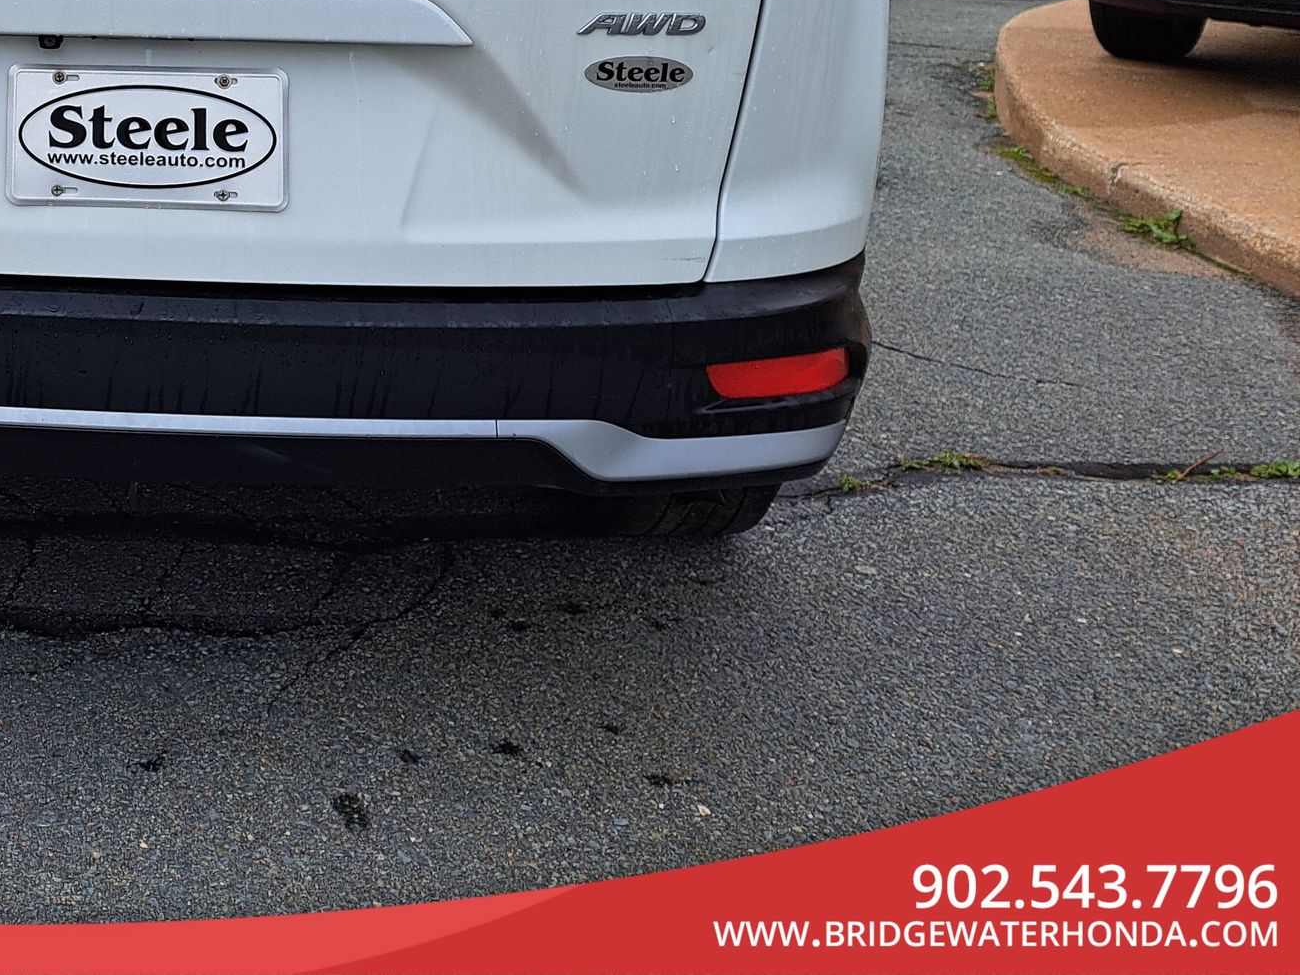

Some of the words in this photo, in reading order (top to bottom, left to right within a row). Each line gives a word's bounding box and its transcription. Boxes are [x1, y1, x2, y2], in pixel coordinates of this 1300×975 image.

[576, 11, 707, 36] AWD
[596, 61, 686, 83] Steele
[47, 104, 249, 153] Steele
[47, 151, 247, 169] www.steeleauto.com
